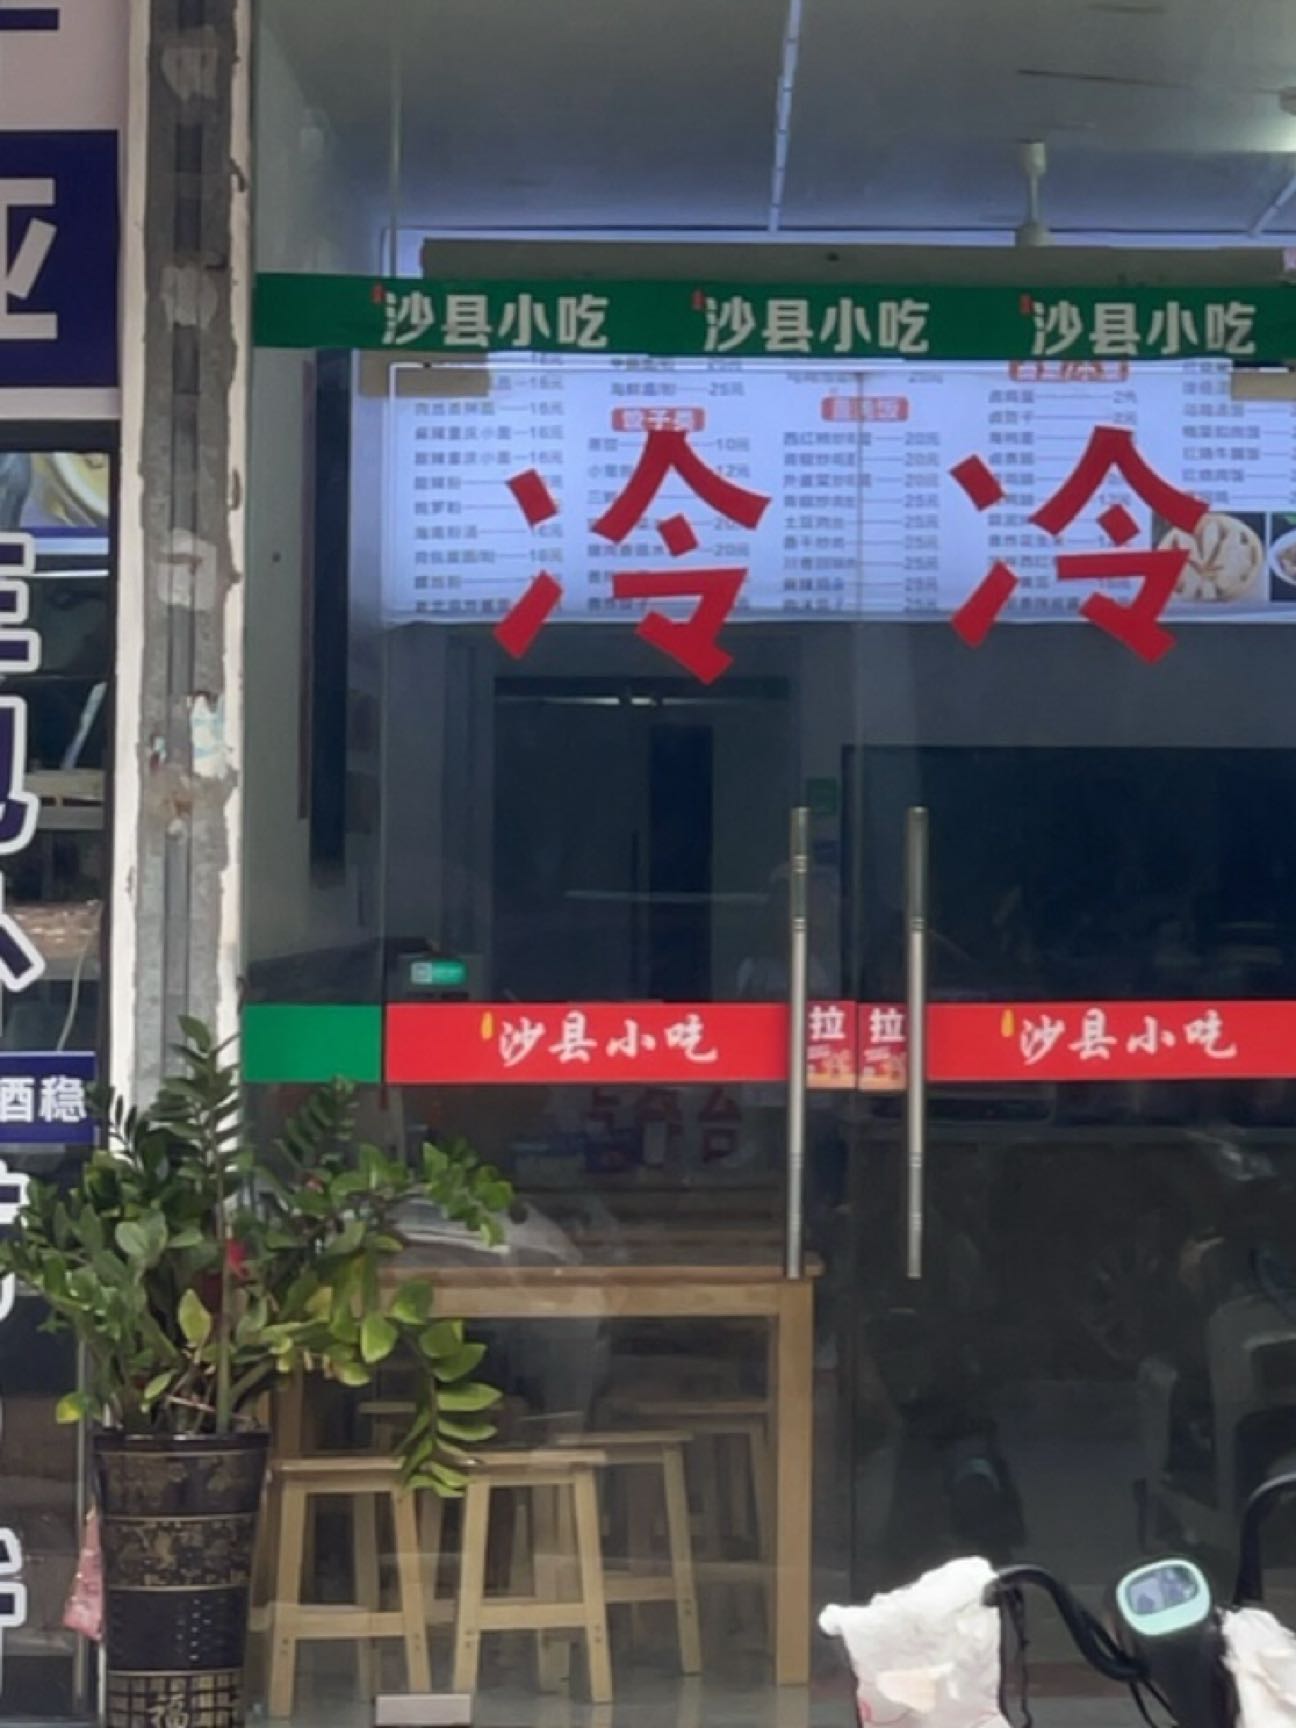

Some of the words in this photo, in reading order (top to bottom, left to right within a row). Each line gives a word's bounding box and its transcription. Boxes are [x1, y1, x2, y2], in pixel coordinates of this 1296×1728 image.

[382, 290, 609, 348] 沙县小吃
[704, 295, 929, 353] 沙县小吃
[1031, 301, 1256, 355] 沙县小吃
[493, 428, 770, 684] 冷
[950, 429, 1207, 662] 冷
[499, 1010, 718, 1067] 沙县小吃
[808, 1005, 846, 1040] 拉
[1020, 1007, 1237, 1065] 沙县小吃
